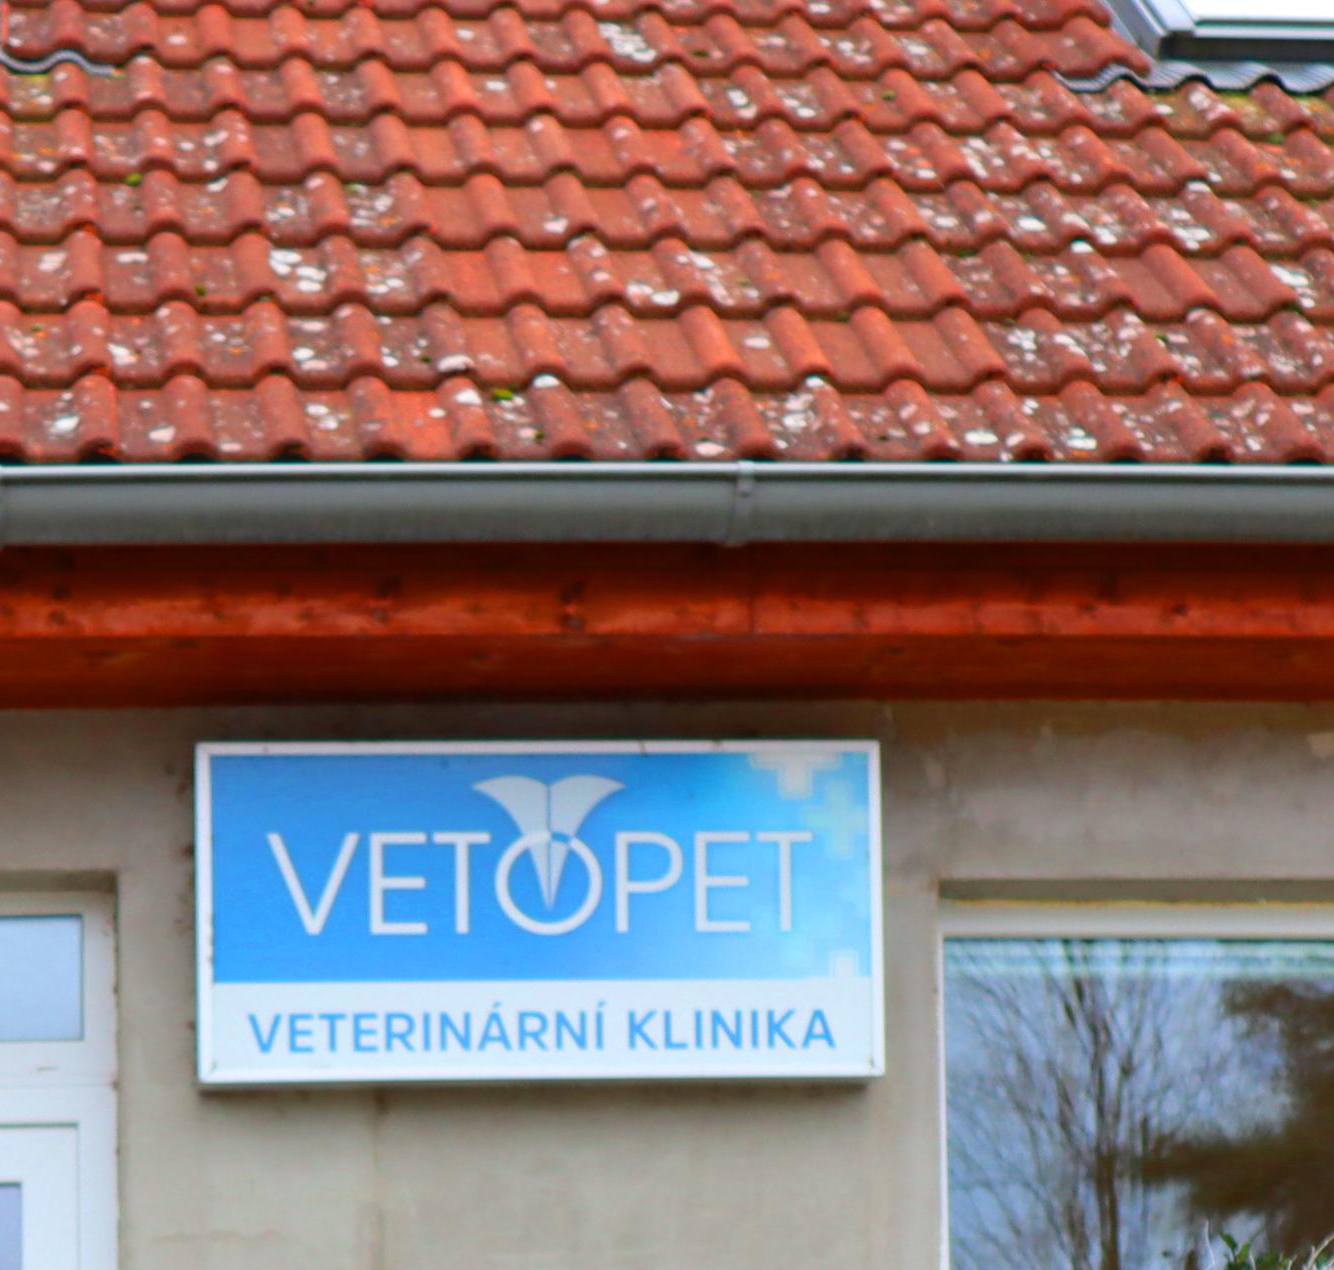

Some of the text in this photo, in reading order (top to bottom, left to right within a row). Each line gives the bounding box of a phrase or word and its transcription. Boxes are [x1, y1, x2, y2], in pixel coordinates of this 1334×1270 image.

[268, 831, 813, 935] VETOPET
[248, 1001, 837, 1053] VETERINÁRNÍ KLINIKA
